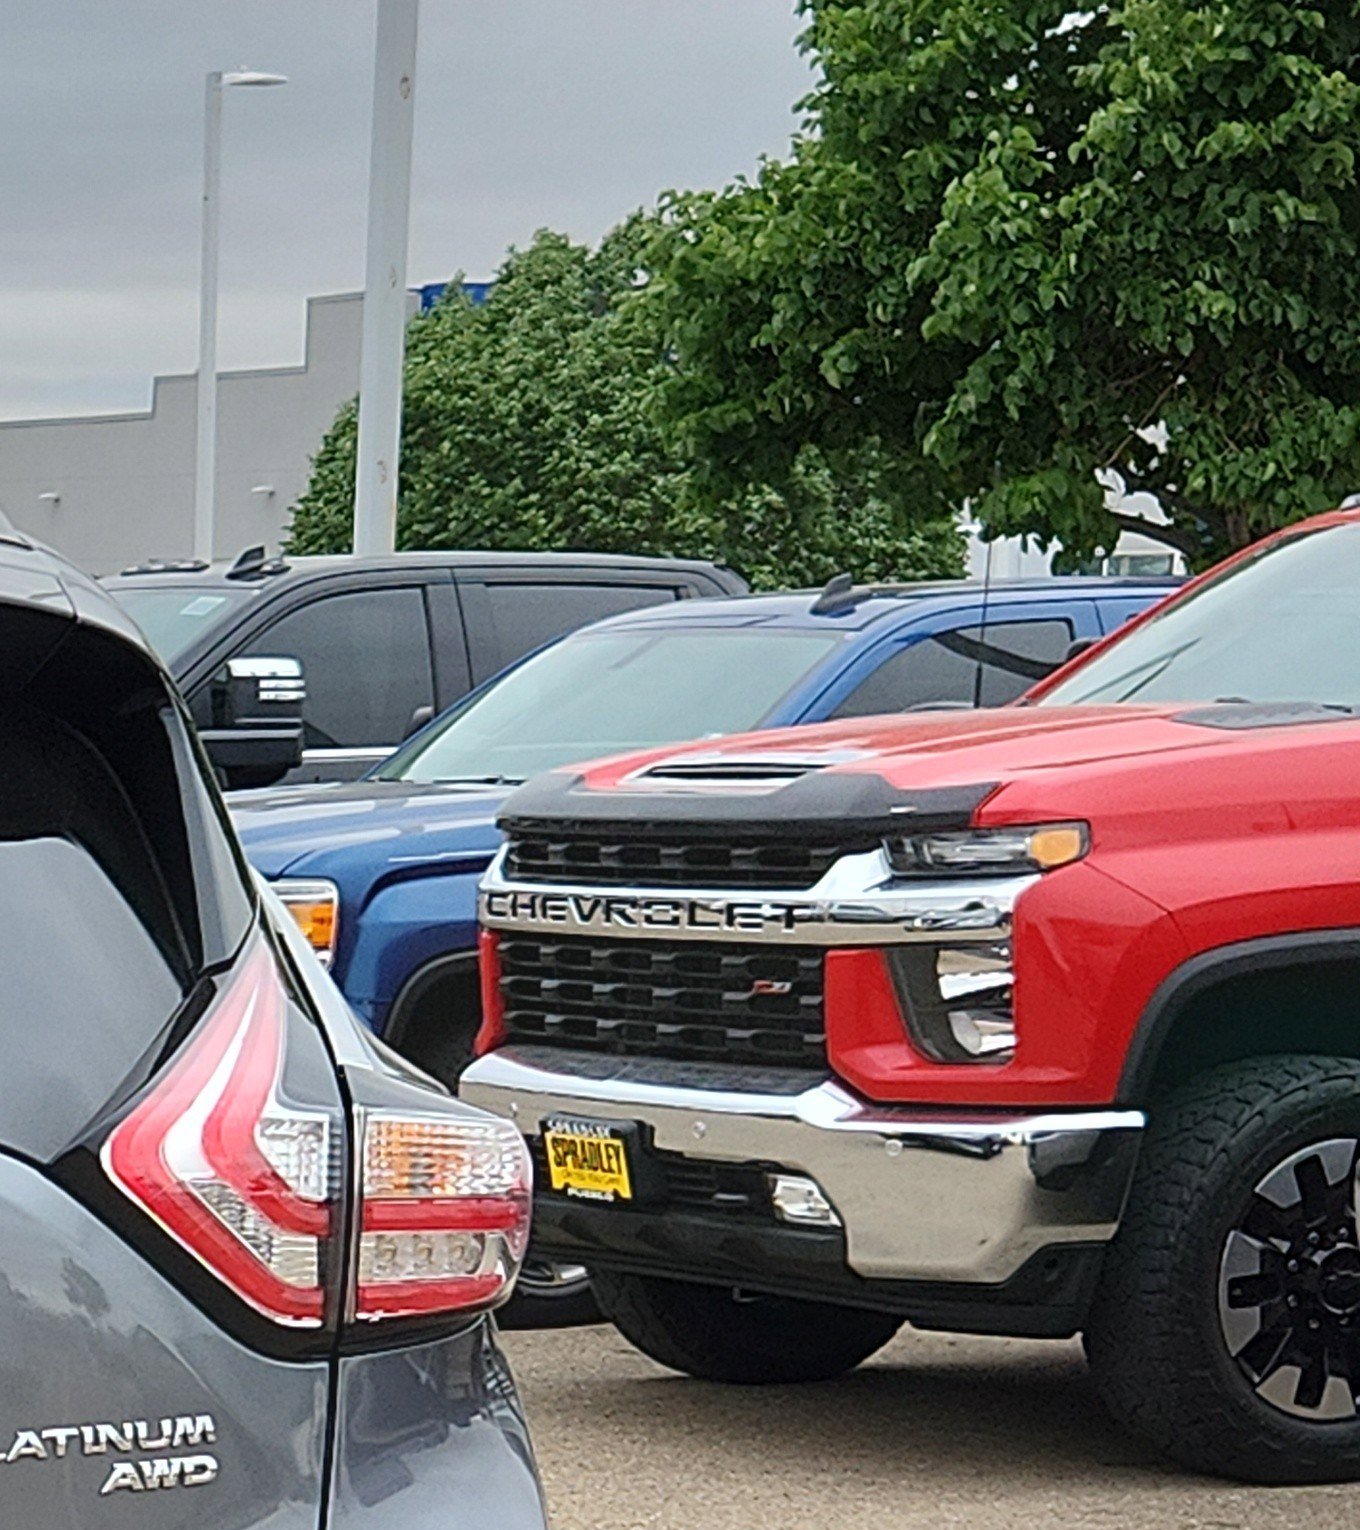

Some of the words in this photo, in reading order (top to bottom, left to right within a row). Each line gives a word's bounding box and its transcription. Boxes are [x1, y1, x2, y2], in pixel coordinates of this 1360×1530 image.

[486, 892, 814, 932] CHEVROLET
[551, 1136, 622, 1175] SPRADLEY
[100, 1455, 219, 1495] AWD
